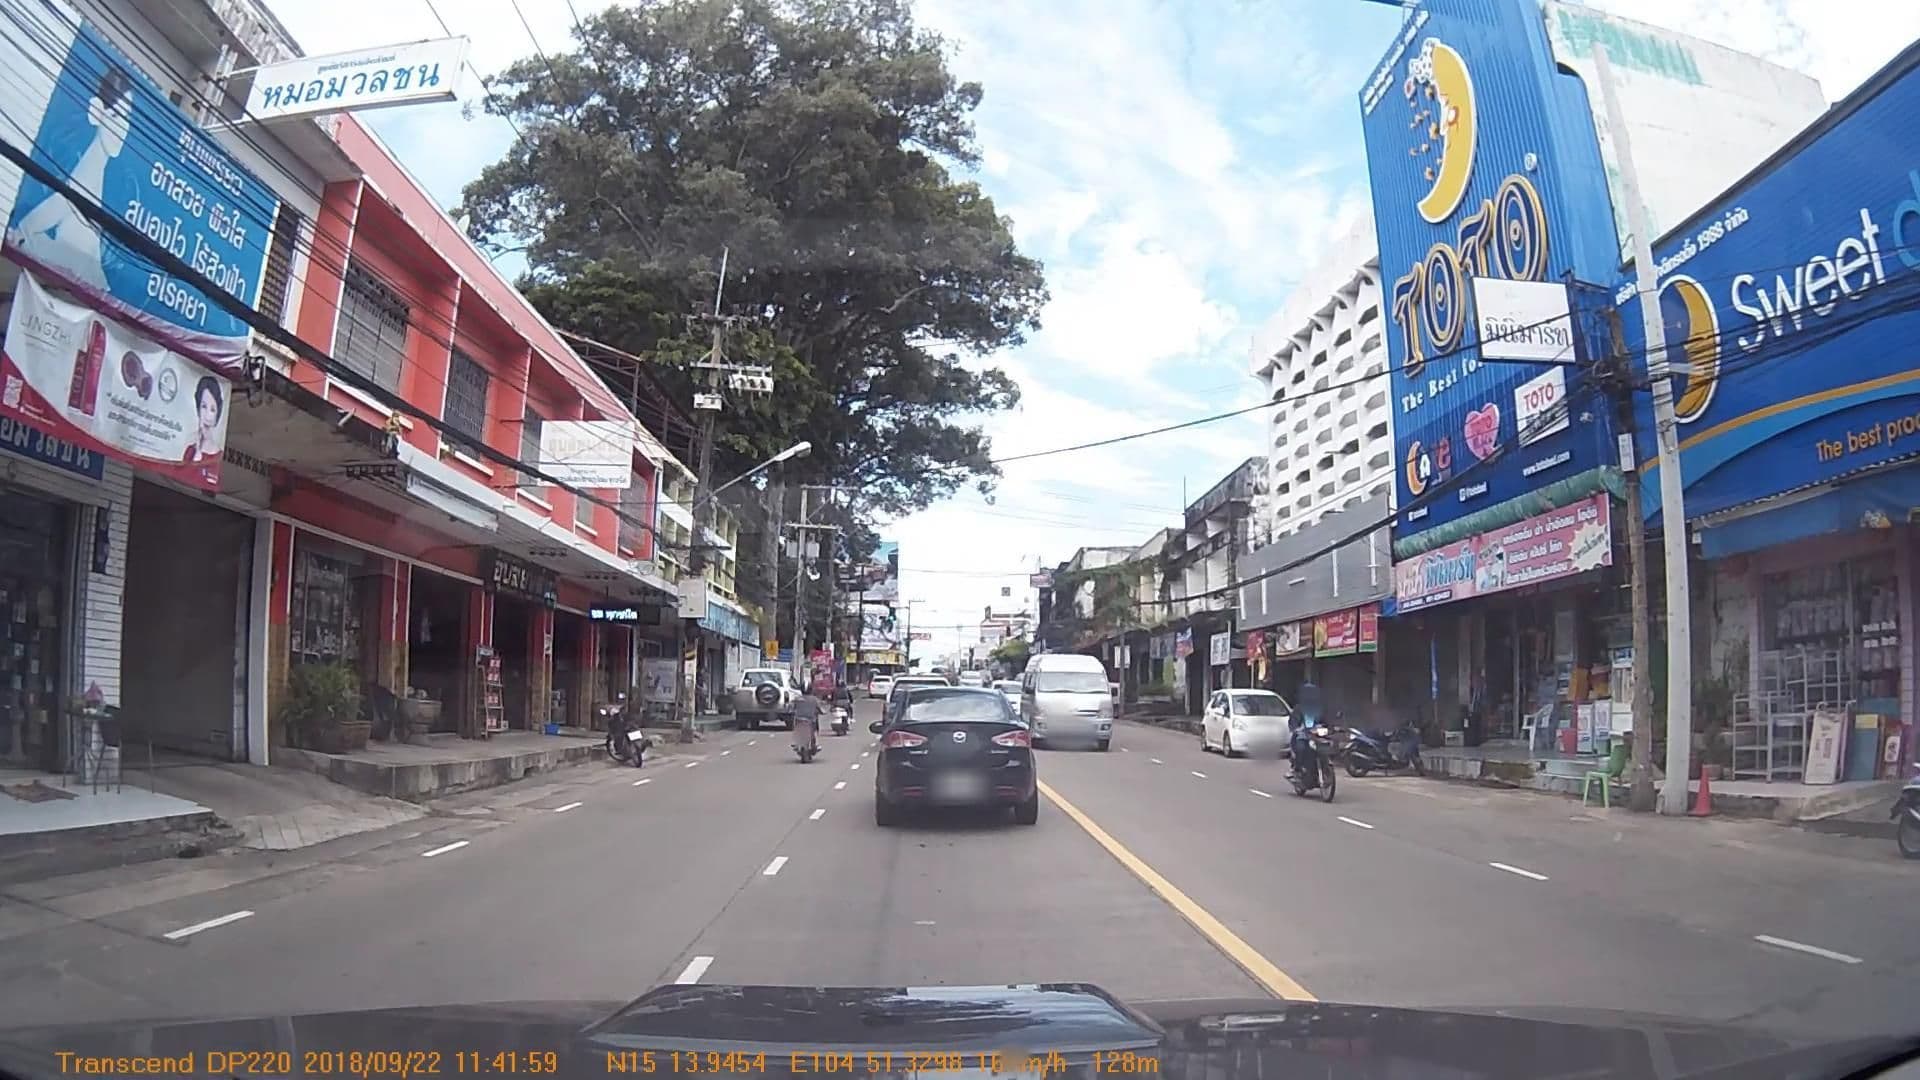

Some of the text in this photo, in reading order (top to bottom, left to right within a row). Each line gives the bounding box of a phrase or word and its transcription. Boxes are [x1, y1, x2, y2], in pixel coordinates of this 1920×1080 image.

[151, 161, 246, 250] อกสวย ผิวใส
[124, 200, 246, 301] สมองไว ไร้สิวฝ้า
[147, 273, 207, 327] อโรคยา
[1731, 208, 1886, 353] Sweet
[1402, 391, 1424, 413] The
[1429, 369, 1458, 398] Best
[1523, 382, 1554, 411] TOTO
[1816, 440, 1843, 462] The
[1846, 423, 1882, 453] best
